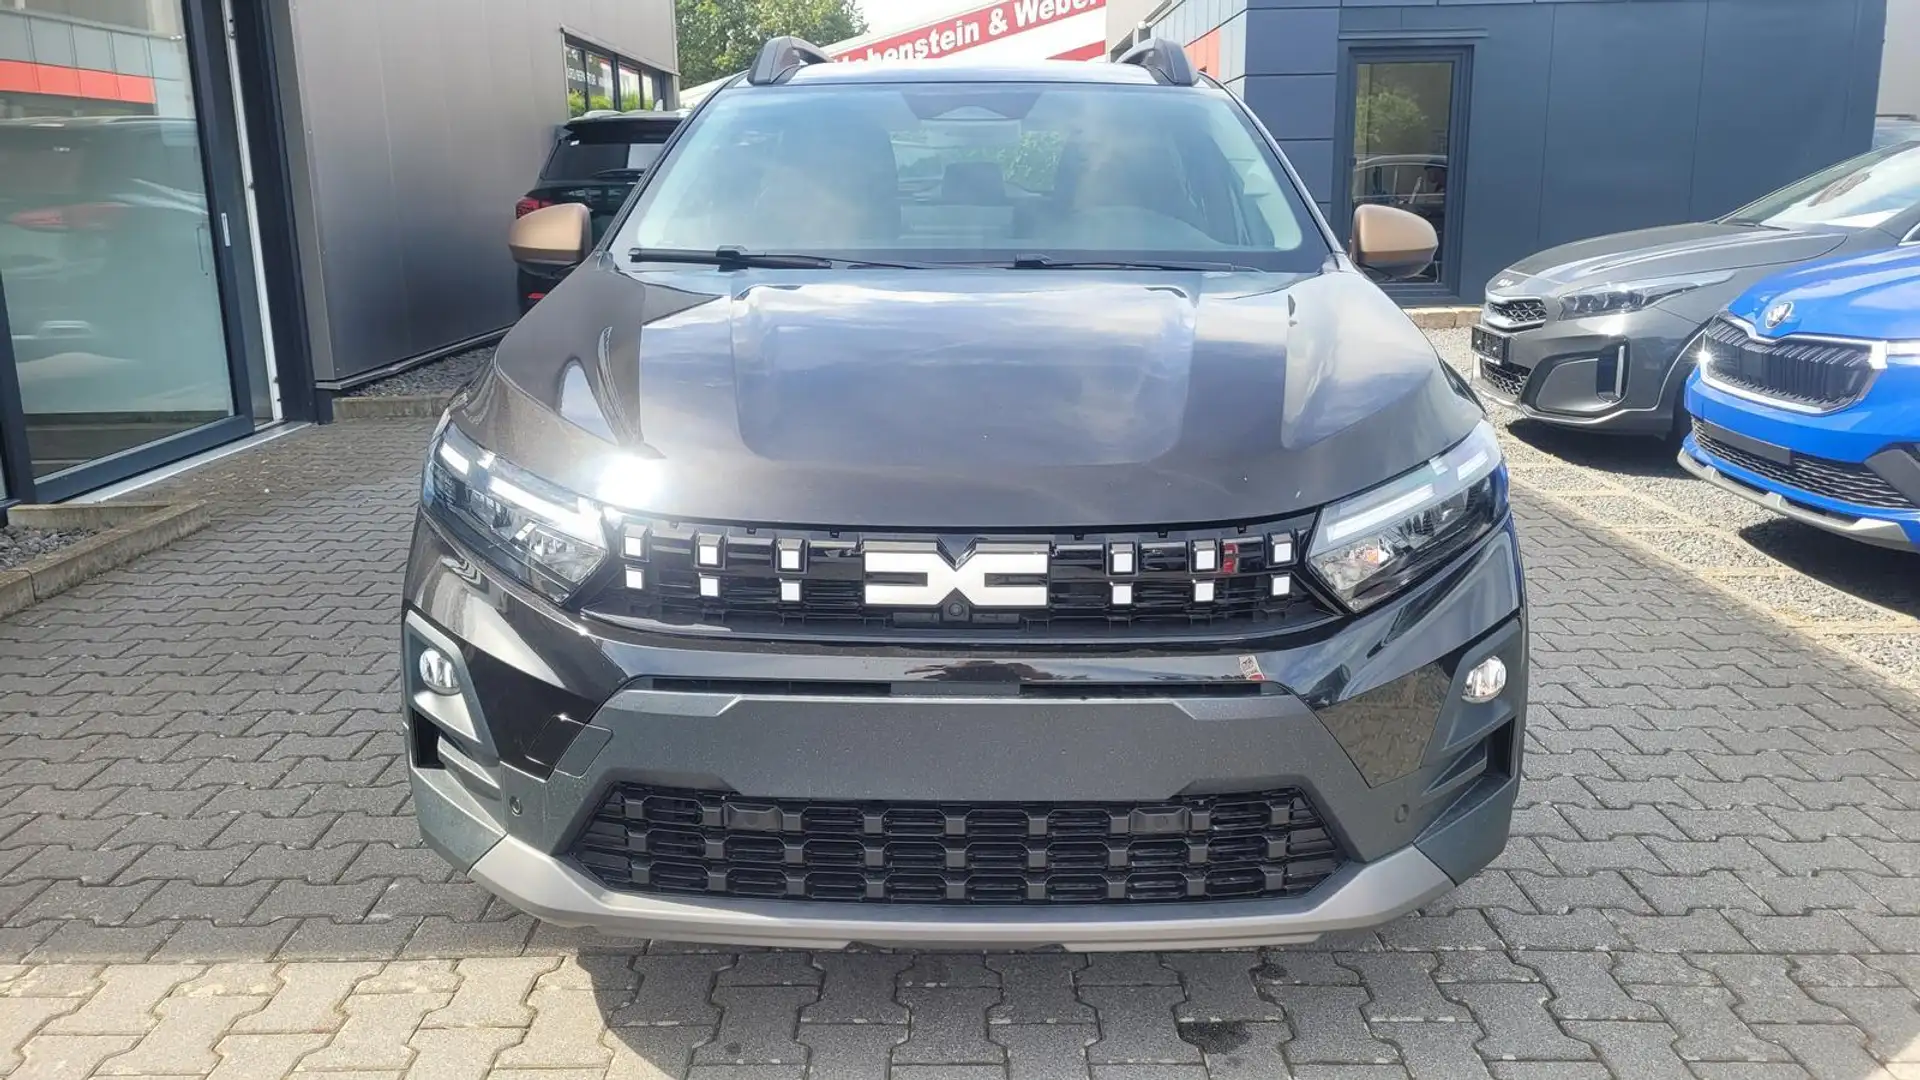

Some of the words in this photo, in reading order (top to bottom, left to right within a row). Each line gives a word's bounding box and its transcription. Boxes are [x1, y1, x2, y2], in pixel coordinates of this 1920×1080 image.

[834, 21, 980, 62] henstein
[988, 8, 1007, 36] &
[1013, 0, 1097, 27] Web
